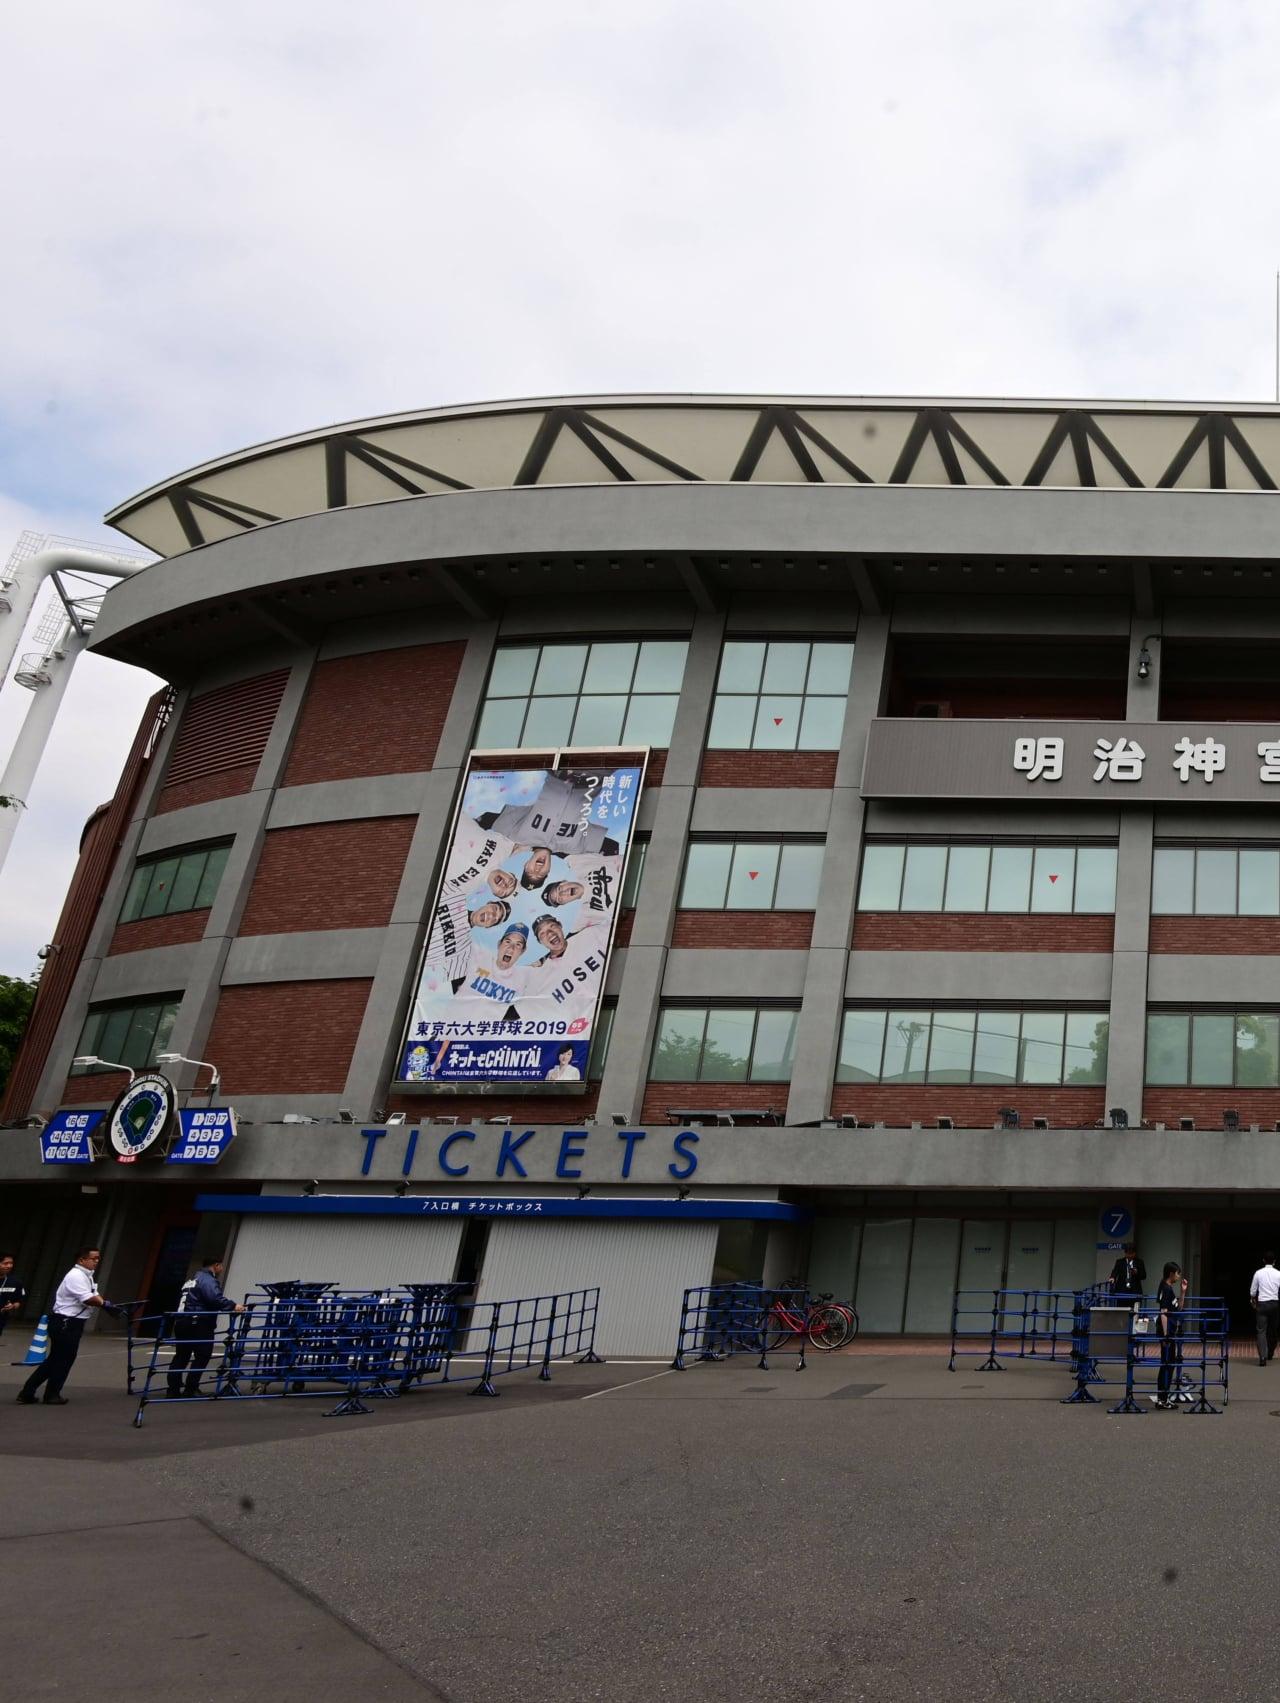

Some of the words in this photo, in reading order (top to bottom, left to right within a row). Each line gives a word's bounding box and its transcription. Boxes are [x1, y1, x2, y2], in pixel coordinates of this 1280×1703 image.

[597, 775, 616, 818] 時代を
[613, 775, 632, 817] 新しい
[470, 976, 517, 1004] TOKYO
[552, 949, 607, 1004] HOSEI
[416, 1020, 567, 1037] 東京六大学野球2019
[360, 1129, 700, 1179] TICKETS
[468, 1202, 543, 1212] チケットボックス
[1110, 1213, 1125, 1233] 7
